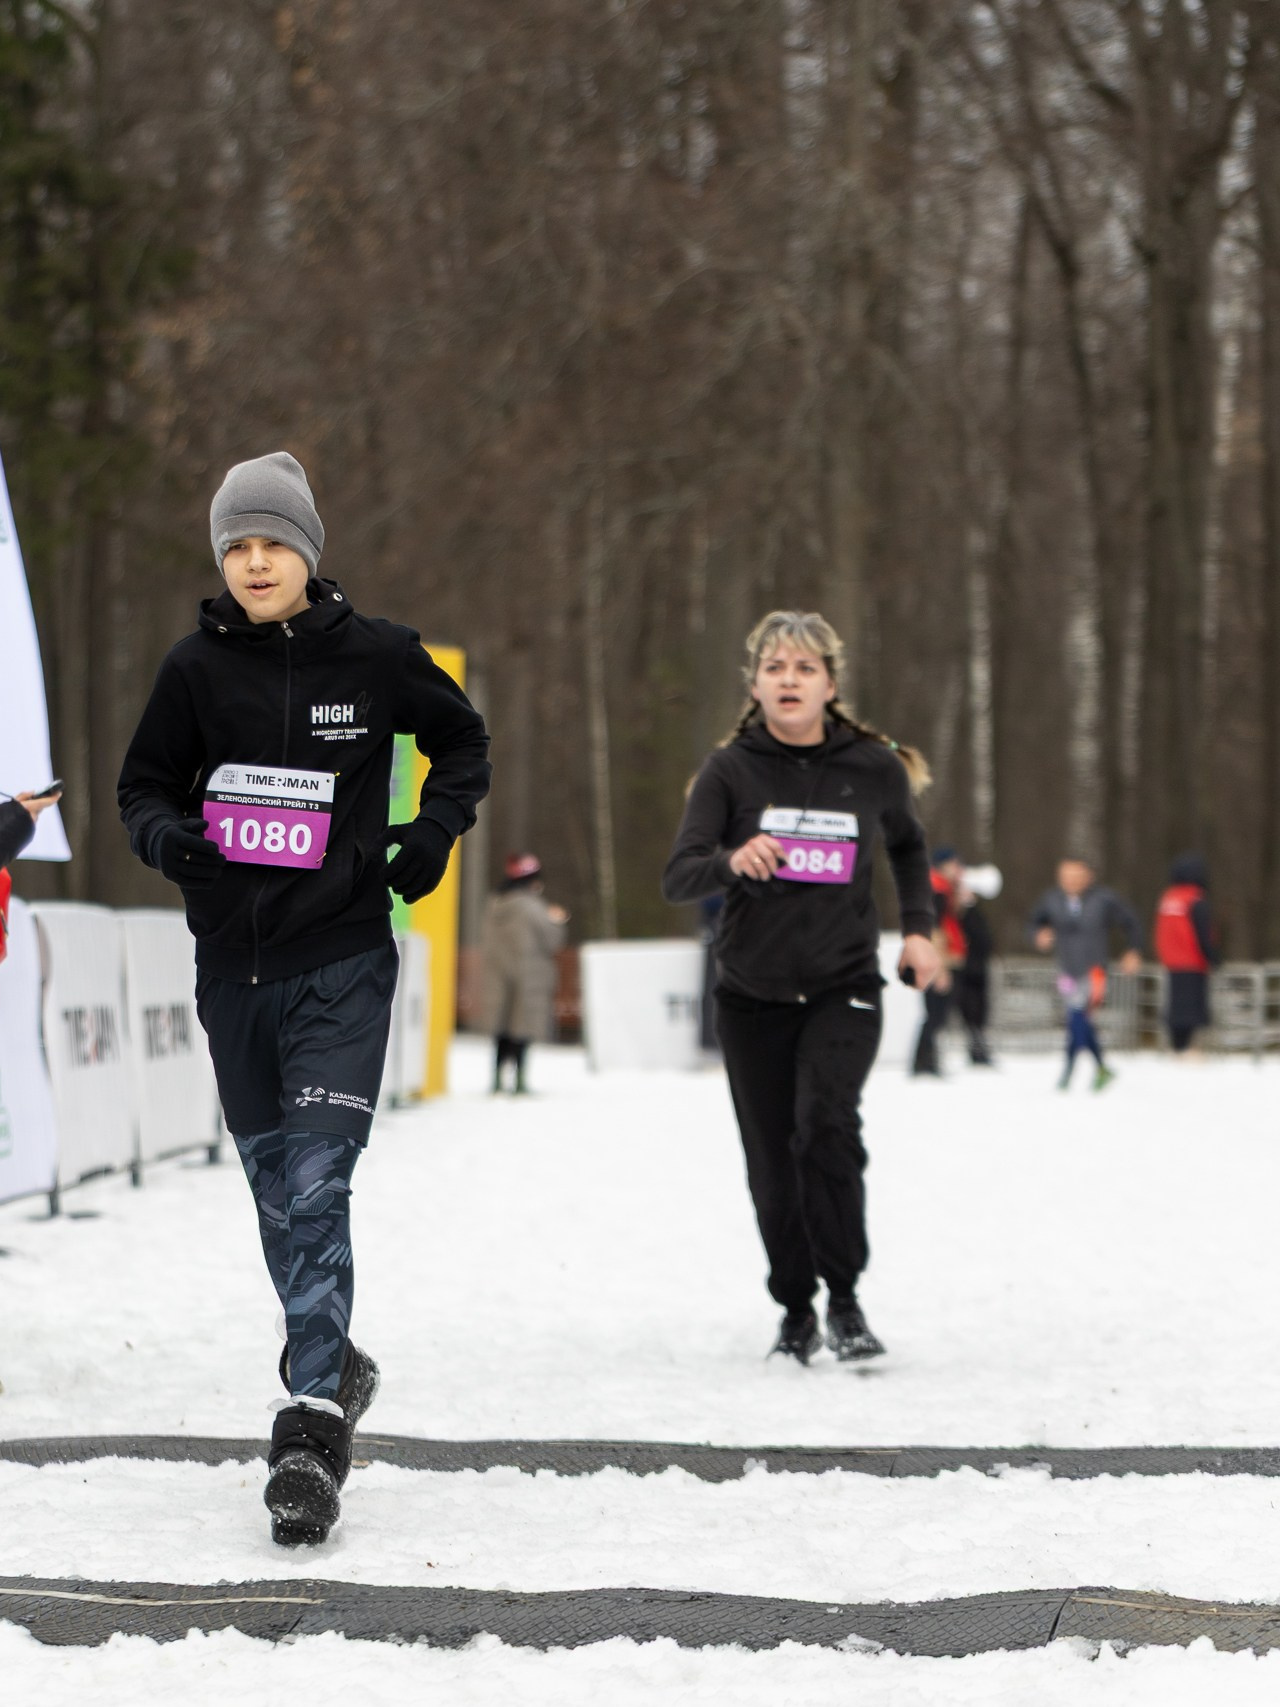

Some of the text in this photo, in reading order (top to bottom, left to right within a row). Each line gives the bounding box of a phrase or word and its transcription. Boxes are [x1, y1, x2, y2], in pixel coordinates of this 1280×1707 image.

[311, 704, 355, 724] HIGH
[216, 793, 282, 808] ЗЕЛЕНОДОЛЬСКИЙ
[283, 799, 307, 809] ТРЕЙЛ
[219, 817, 312, 855] 1080
[788, 847, 844, 875] 084
[328, 1098, 372, 1114] ВЕРТОЛЕТНЫЙ
[329, 1091, 369, 1105] КАЗАНСКИЙ
